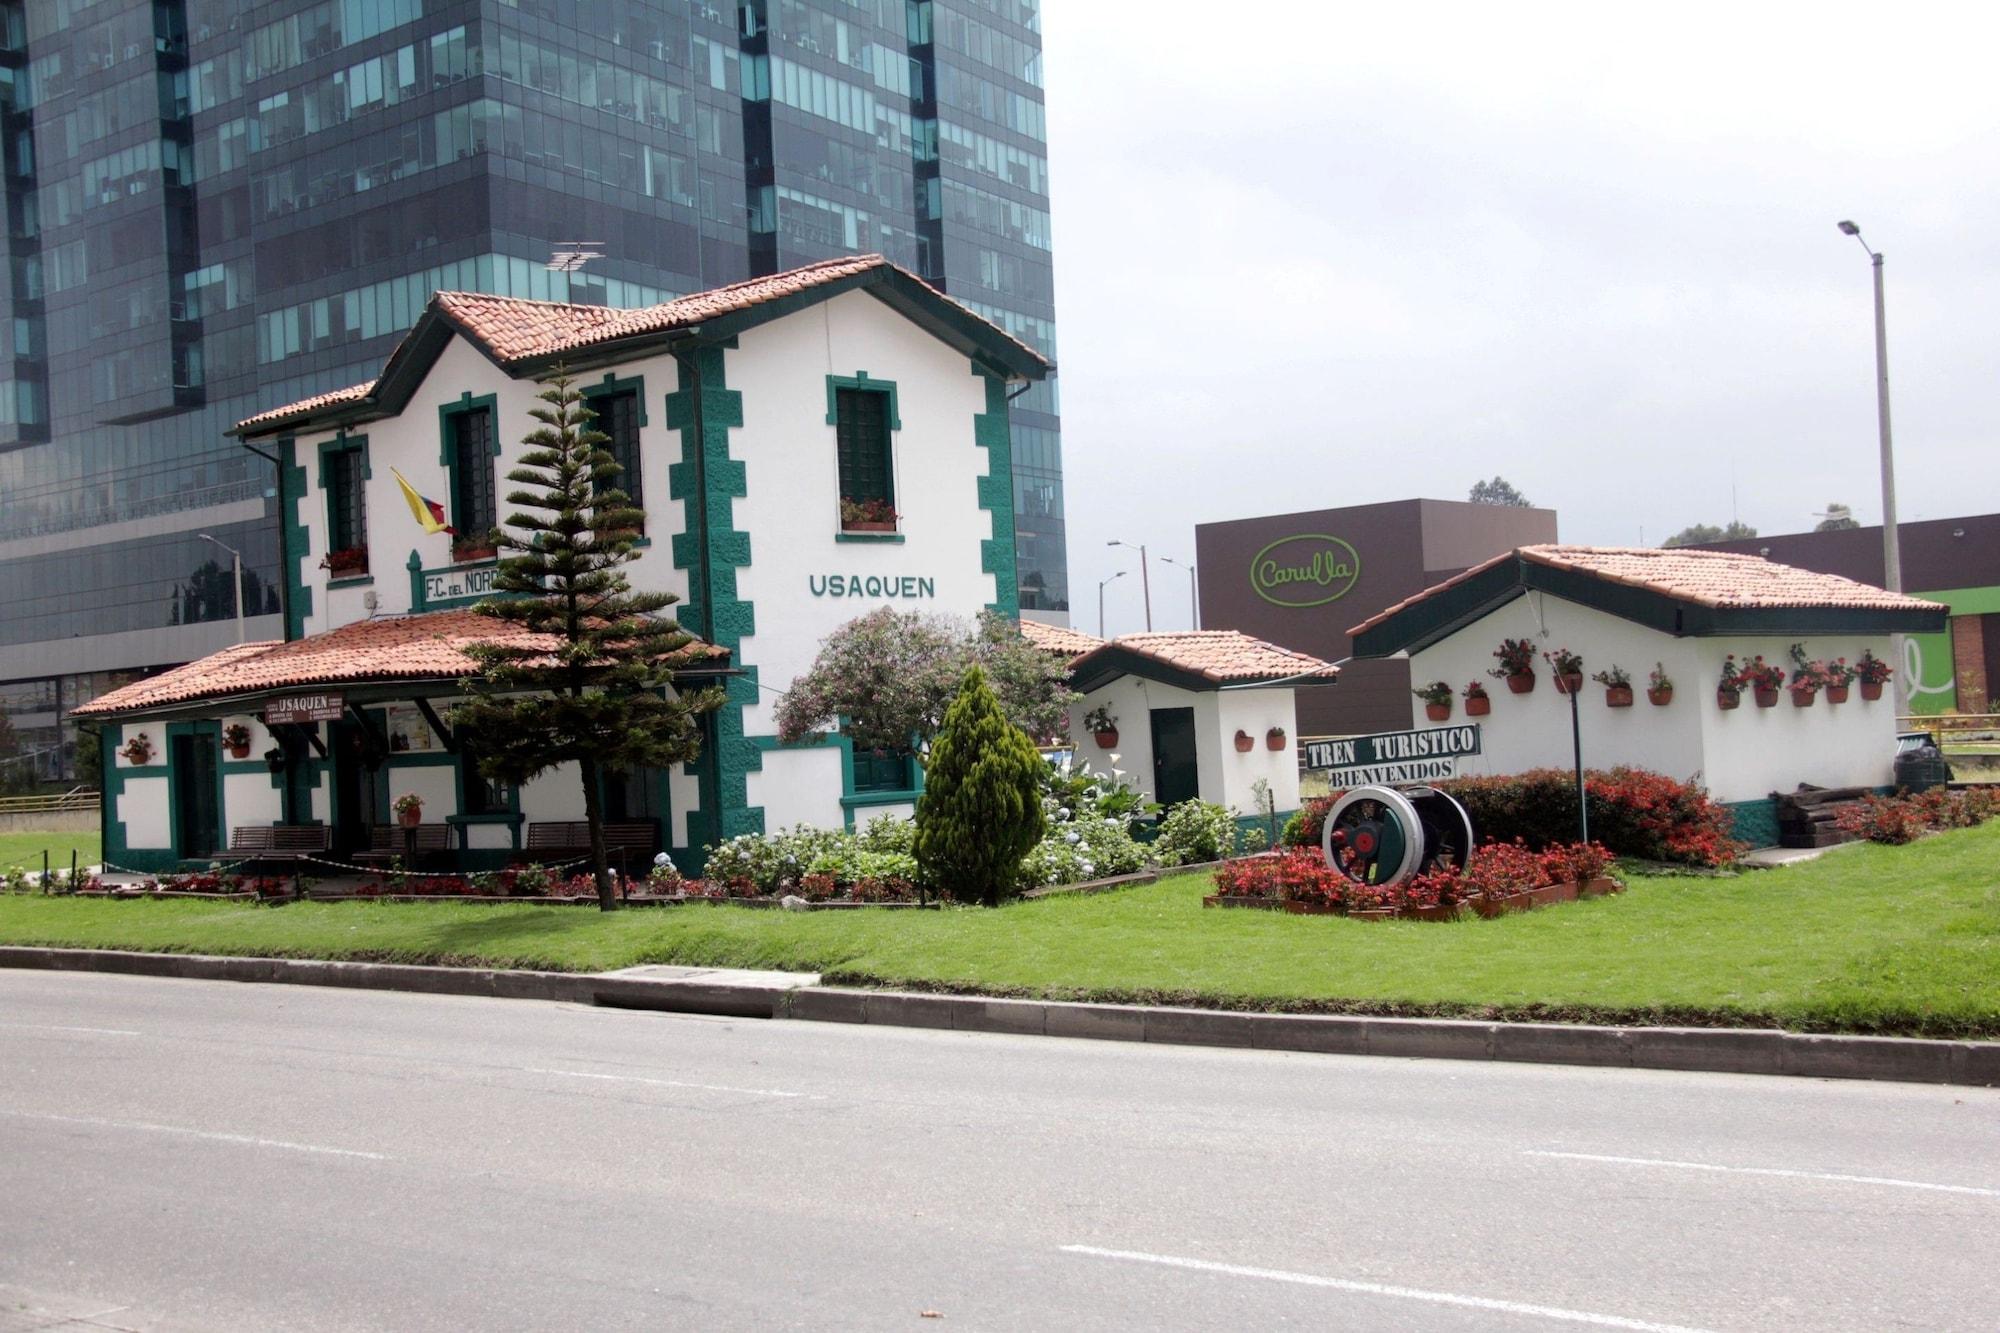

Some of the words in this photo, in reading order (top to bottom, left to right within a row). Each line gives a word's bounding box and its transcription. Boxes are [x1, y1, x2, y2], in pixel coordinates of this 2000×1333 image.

[1260, 550, 1352, 587] Carulla
[449, 584, 463, 597] DEL
[809, 574, 935, 598] USAQUEN
[279, 695, 328, 712] USAQUEN
[1308, 740, 1355, 767] TREN
[1372, 727, 1474, 760] TURISTICO
[1331, 761, 1451, 788] BIENVENIDOS
